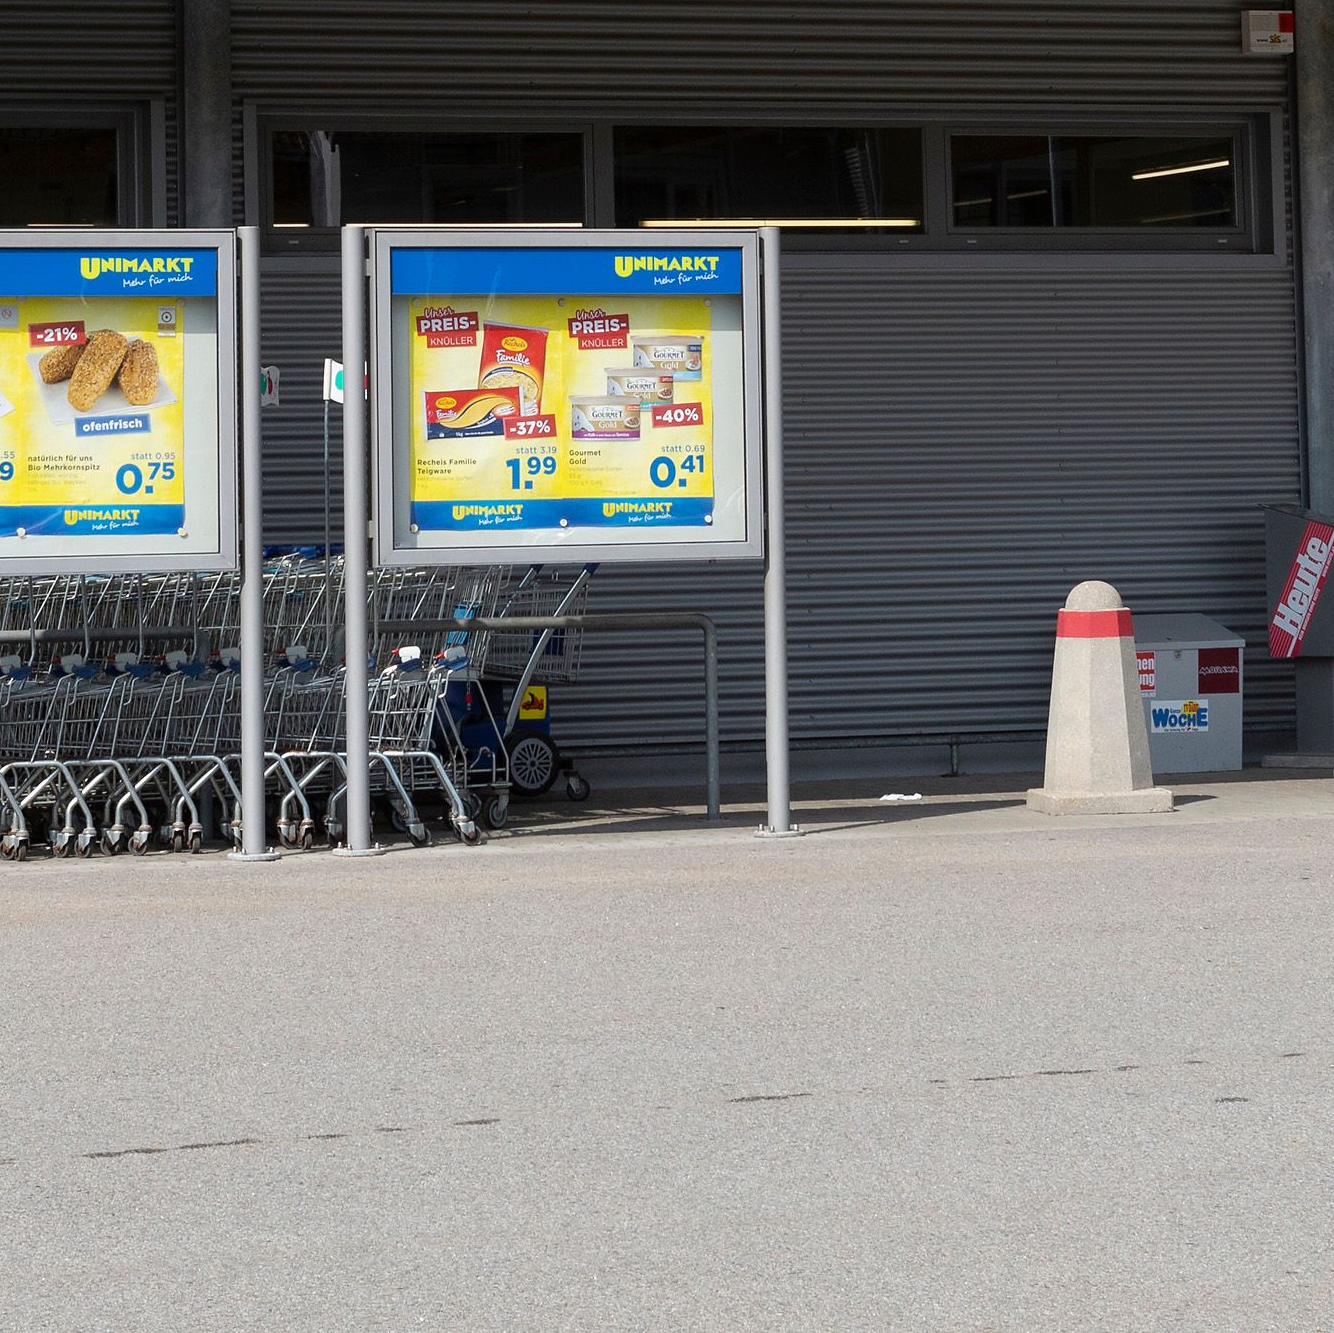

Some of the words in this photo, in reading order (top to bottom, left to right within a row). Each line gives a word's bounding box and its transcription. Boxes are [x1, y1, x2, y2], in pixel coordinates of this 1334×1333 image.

[80, 258, 193, 279] UNIMARKT
[614, 256, 719, 278] UNIMARKT
[123, 278, 146, 288] Mehr
[149, 275, 165, 287] für
[168, 273, 194, 283] mich
[653, 276, 675, 286] Mehr
[678, 272, 692, 285] für
[695, 271, 719, 281] mich
[424, 307, 454, 318] Unser
[576, 309, 604, 320] Unser
[420, 316, 476, 333] PREIS-
[572, 318, 627, 335] PREIS-
[36, 327, 78, 342] -21%
[430, 336, 473, 346] KNÜLLER
[581, 339, 624, 348] KNÜLLER
[495, 349, 530, 365] Familie
[653, 349, 685, 359] GOURMET
[660, 361, 679, 370] Gold
[626, 381, 657, 390] GOURMET
[591, 409, 622, 418] GOURMET
[655, 407, 699, 422] -40%
[83, 418, 143, 432] ofenfrisch
[509, 420, 551, 435] -37%
[599, 420, 617, 429] Gold
[131, 452, 152, 460] statt
[155, 452, 176, 460] 0.95
[516, 446, 537, 454] statt
[540, 446, 557, 454] 3.19
[685, 445, 705, 453] 0.69
[28, 454, 63, 462] natürlich
[65, 454, 78, 462] für
[43, 464, 100, 473] Mehrkornspitz
[417, 468, 452, 476] Teigware
[505, 456, 557, 490] 1.99
[649, 455, 704, 488] 0.41
[115, 462, 175, 495] 0.75
[452, 505, 523, 520] UNIMARKT
[603, 502, 673, 518] UNIMARKT
[64, 510, 139, 525] UNIMARKT
[495, 516, 505, 525] für
[644, 514, 654, 523] für
[109, 522, 120, 531] für
[1273, 537, 1328, 636] Heute
[1152, 707, 1208, 728] WOCHE
